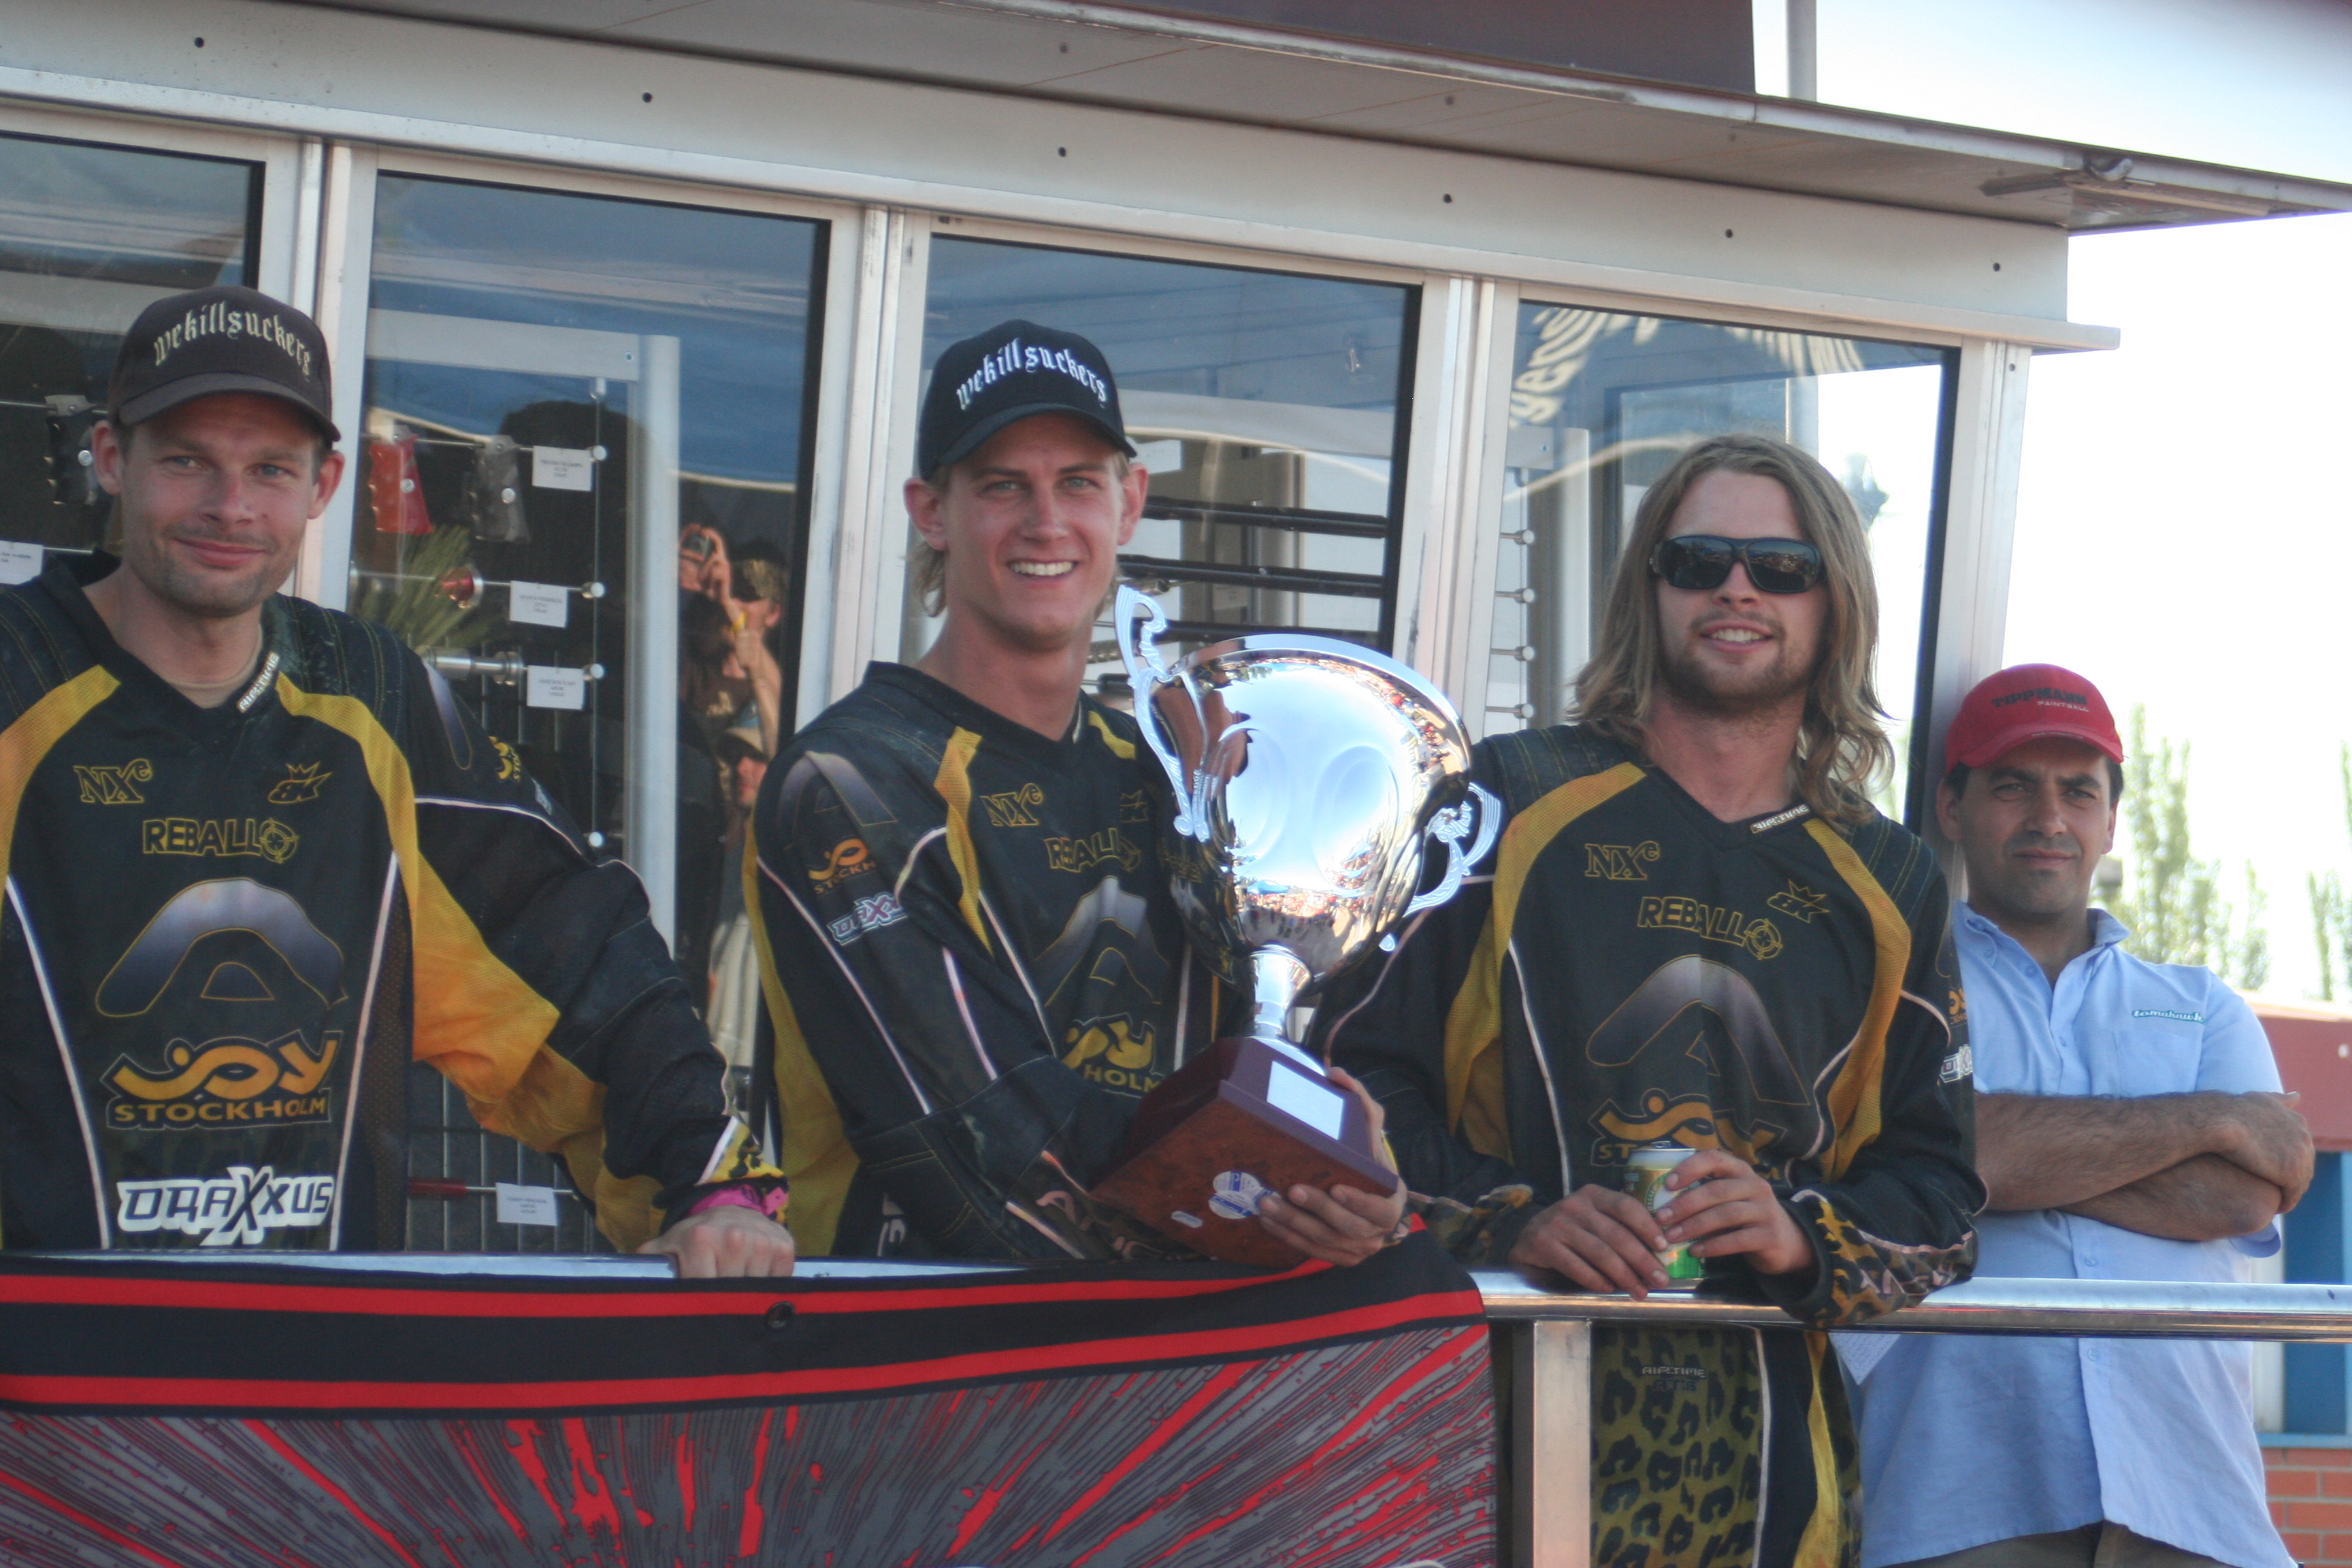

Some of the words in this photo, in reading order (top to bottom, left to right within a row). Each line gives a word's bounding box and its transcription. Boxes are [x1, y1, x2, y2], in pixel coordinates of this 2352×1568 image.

[1992, 687, 2088, 708] TIPPMANN
[2038, 700, 2089, 713] PAINTBALL
[2134, 1010, 2204, 1023] tomahawk
[114, 1097, 326, 1122] STOCKHOLM
